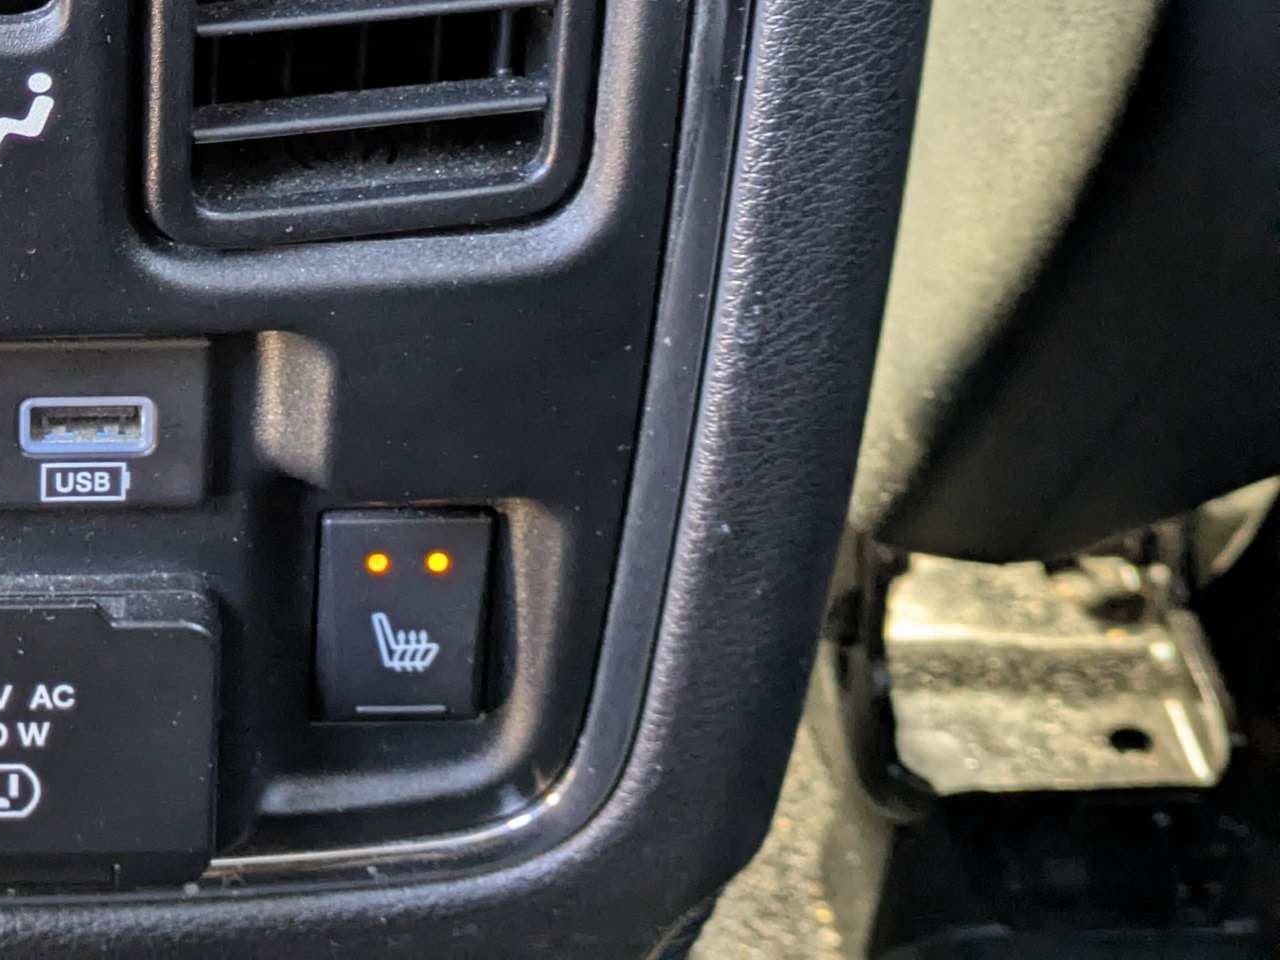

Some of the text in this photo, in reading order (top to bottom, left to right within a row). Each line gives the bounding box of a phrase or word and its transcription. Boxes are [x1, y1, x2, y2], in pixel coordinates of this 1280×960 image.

[54, 471, 112, 495] USB
[28, 683, 77, 711] AC
[16, 721, 52, 748] W
